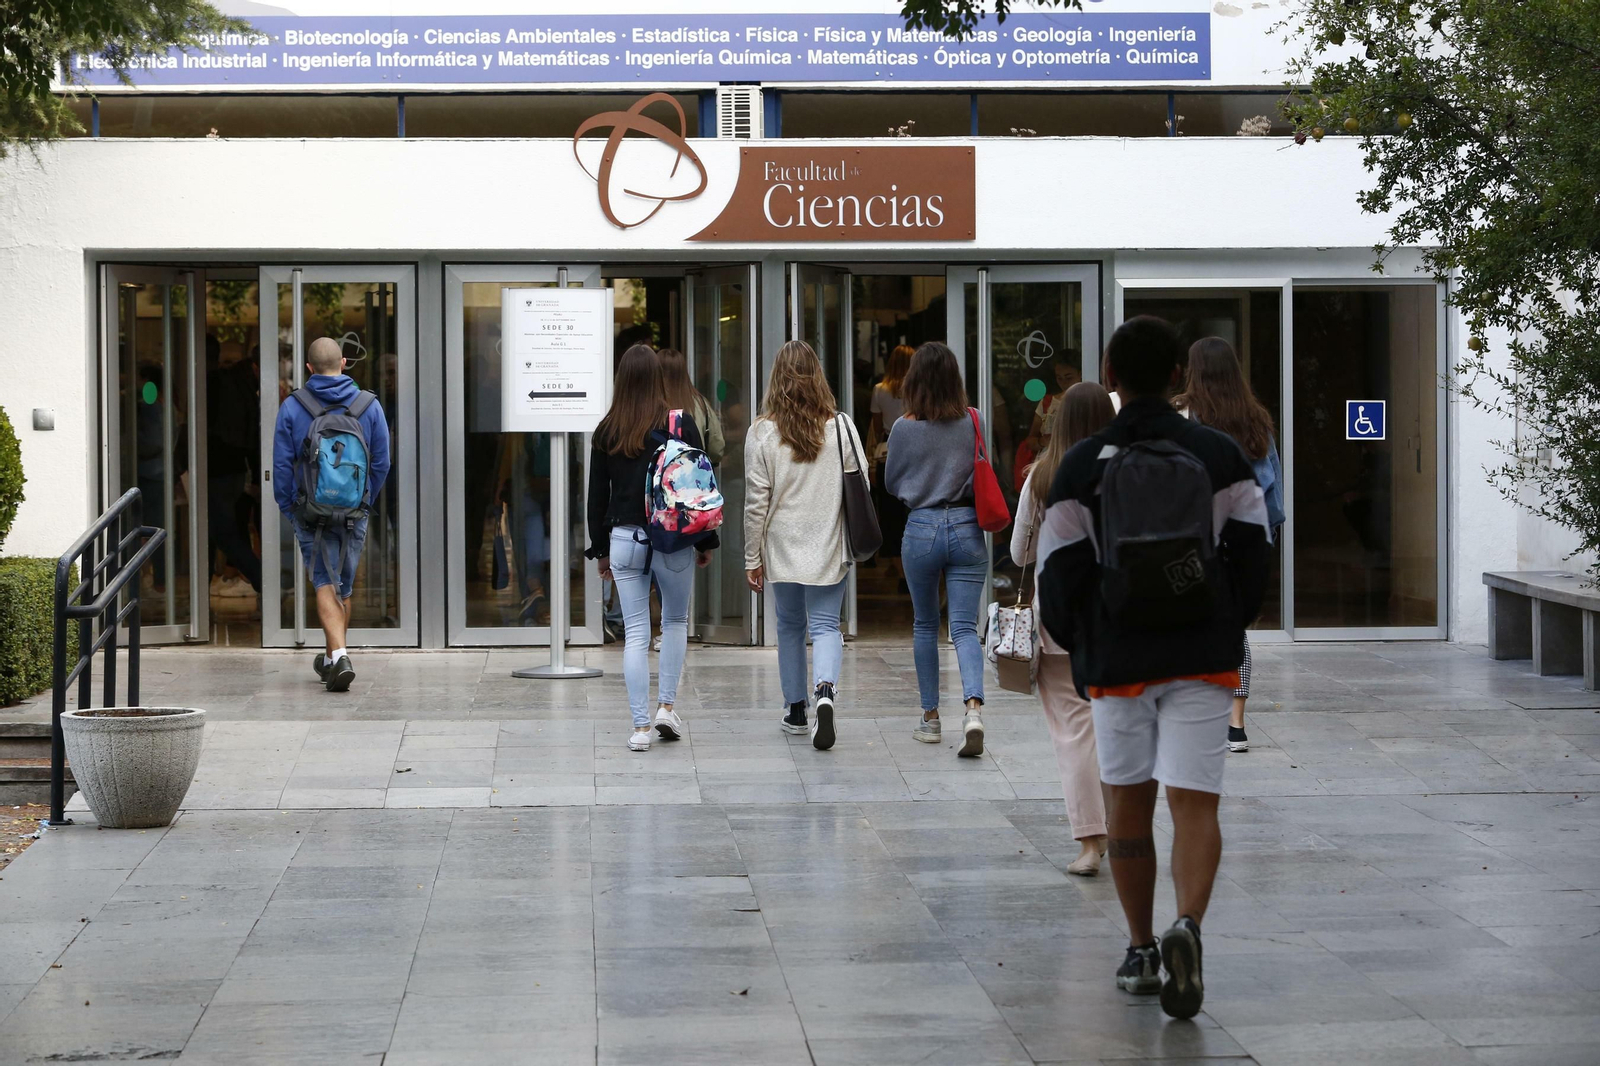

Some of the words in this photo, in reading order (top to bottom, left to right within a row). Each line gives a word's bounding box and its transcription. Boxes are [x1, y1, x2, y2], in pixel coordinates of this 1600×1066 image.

[284, 29, 409, 49] Biotecnología
[424, 28, 501, 45] Ciencias
[505, 28, 617, 44] Ambientales
[632, 27, 730, 43] Estadística
[745, 27, 799, 43] Física
[814, 27, 867, 43] Física
[871, 30, 882, 46] y
[887, 27, 998, 43] Matemicas
[1013, 26, 1092, 46] Geología
[1109, 26, 1196, 46] Ingeniería
[182, 53, 267, 69] Industrial
[282, 52, 372, 72] Ingeniería
[376, 51, 478, 67] Informática
[482, 54, 493, 70] y
[498, 50, 610, 67] Matemáticas
[625, 49, 714, 69] Ingeniería
[718, 49, 792, 66] Química
[807, 48, 919, 66] Matemáticas
[933, 46, 992, 69] Óptica
[996, 53, 1007, 68] y
[1012, 48, 1111, 68] Optometría
[1126, 48, 1199, 65] Química
[763, 160, 846, 182] Facultad
[850, 166, 863, 176] de
[763, 183, 945, 228] Ciencias
